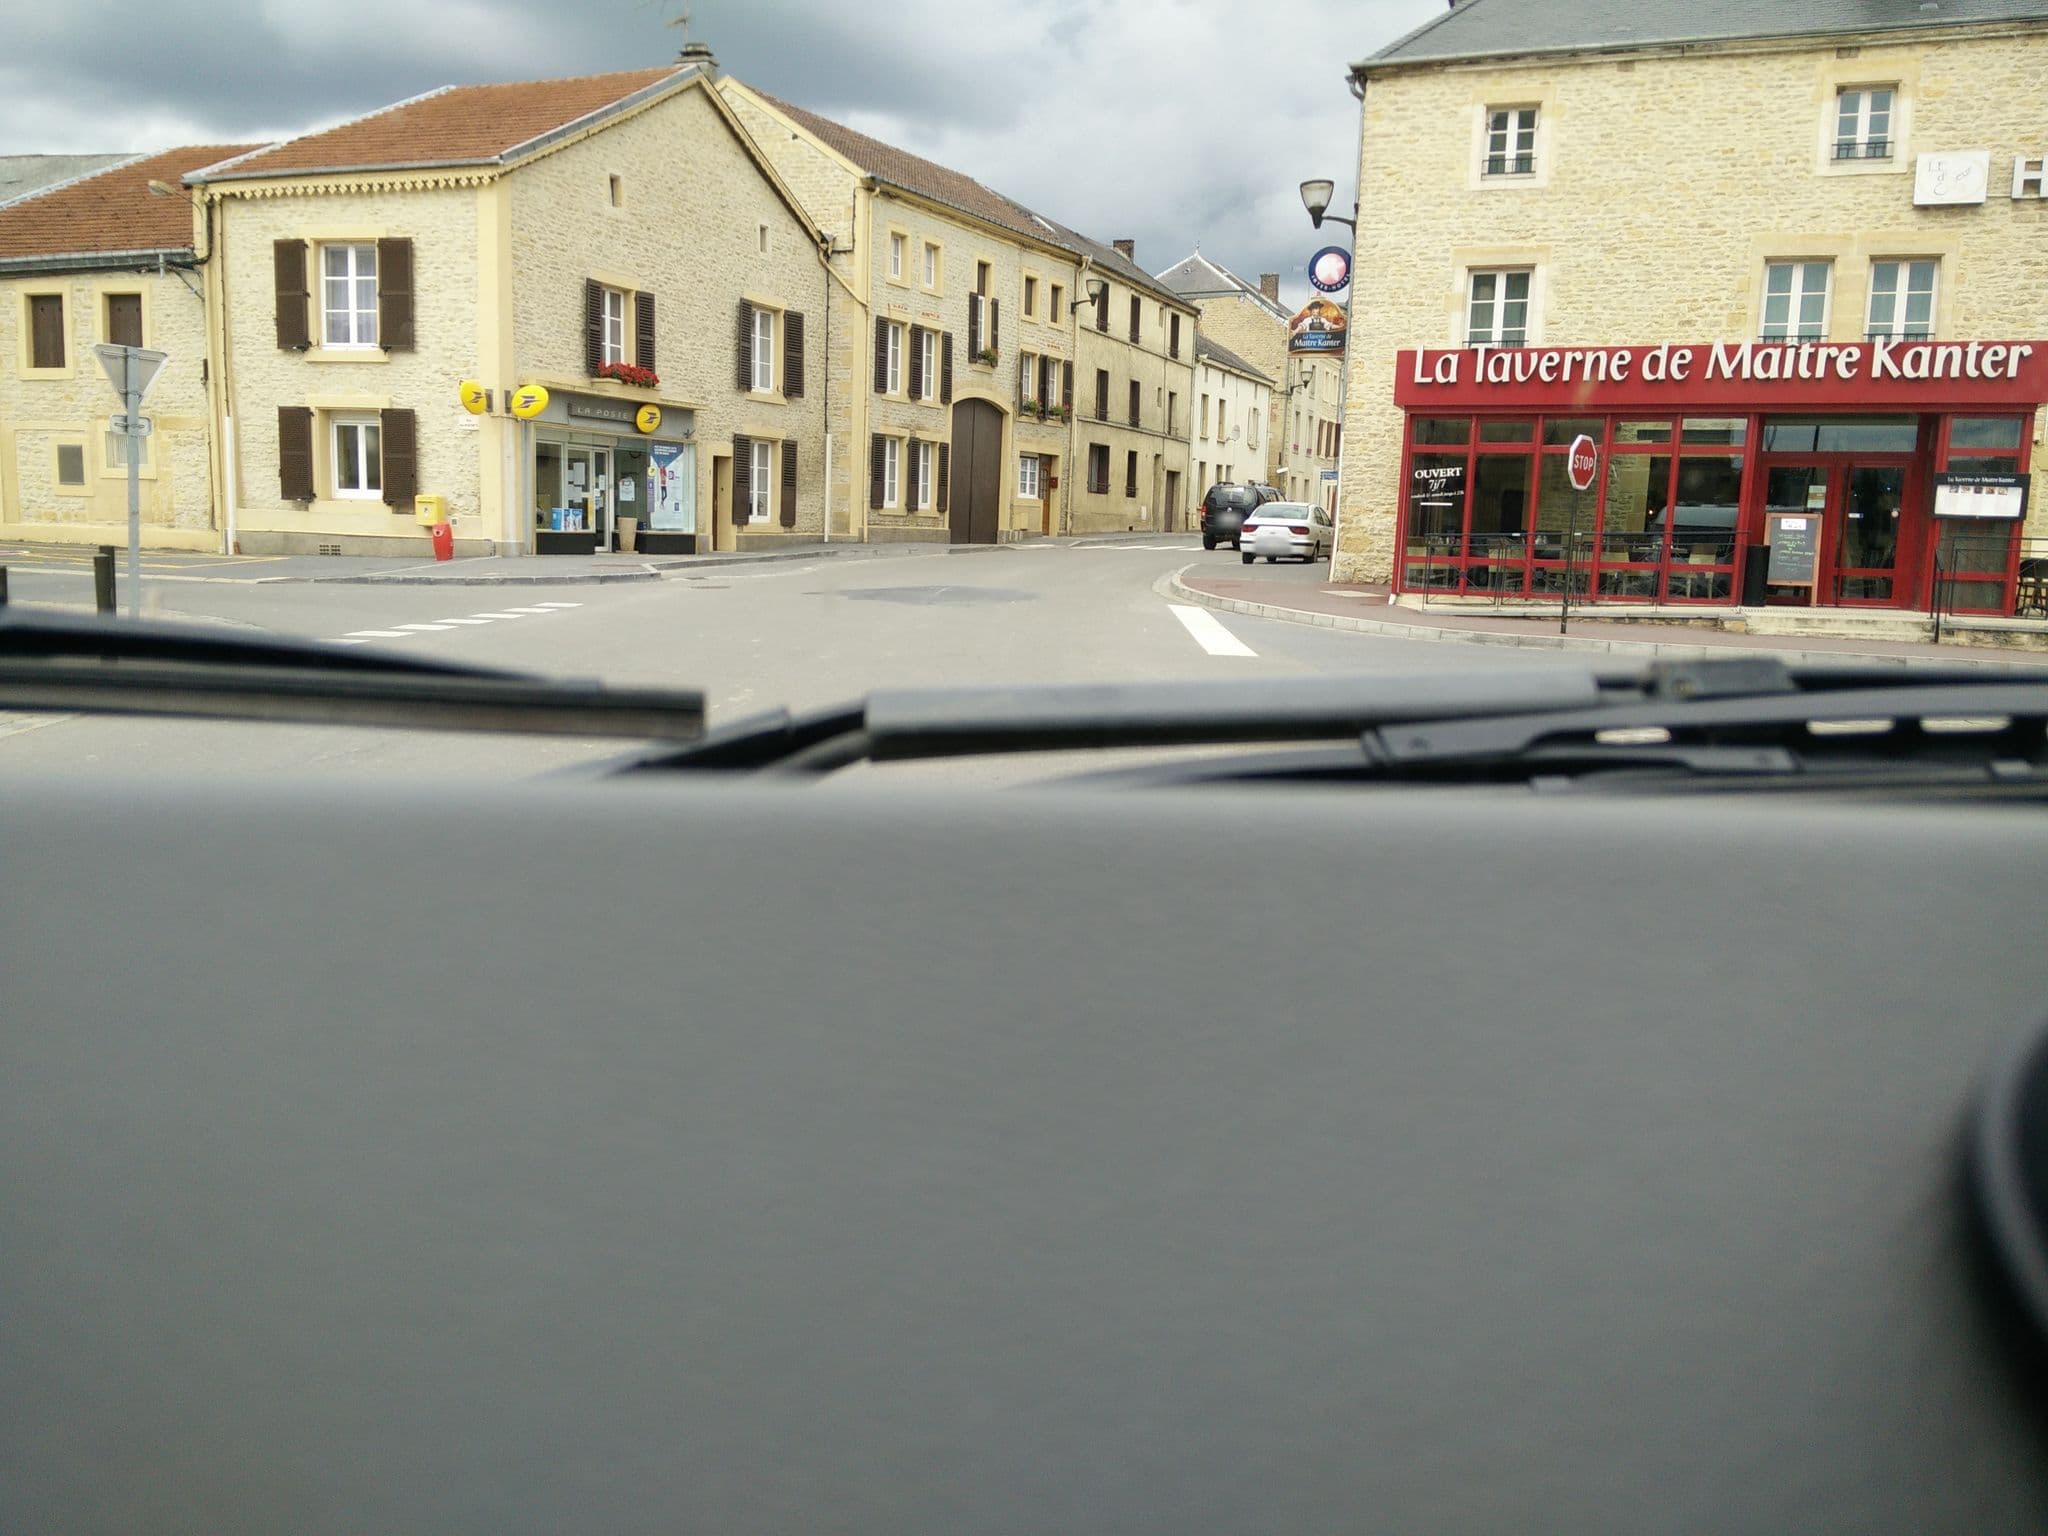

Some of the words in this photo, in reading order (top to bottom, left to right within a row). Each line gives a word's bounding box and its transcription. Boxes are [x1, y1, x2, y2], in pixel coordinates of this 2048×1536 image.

[1317, 339, 1341, 348] Kanter
[1413, 344, 1460, 384] La
[1470, 342, 1632, 384] Taverne
[1640, 340, 1693, 382] de
[1704, 335, 1862, 380] Maître
[1871, 335, 2034, 380] Kanter
[577, 407, 591, 415] LA
[596, 409, 629, 420] POSTE
[1574, 454, 1594, 471] STOP
[1414, 467, 1463, 479] OUVERT
[1428, 478, 1447, 492] 7j/7
